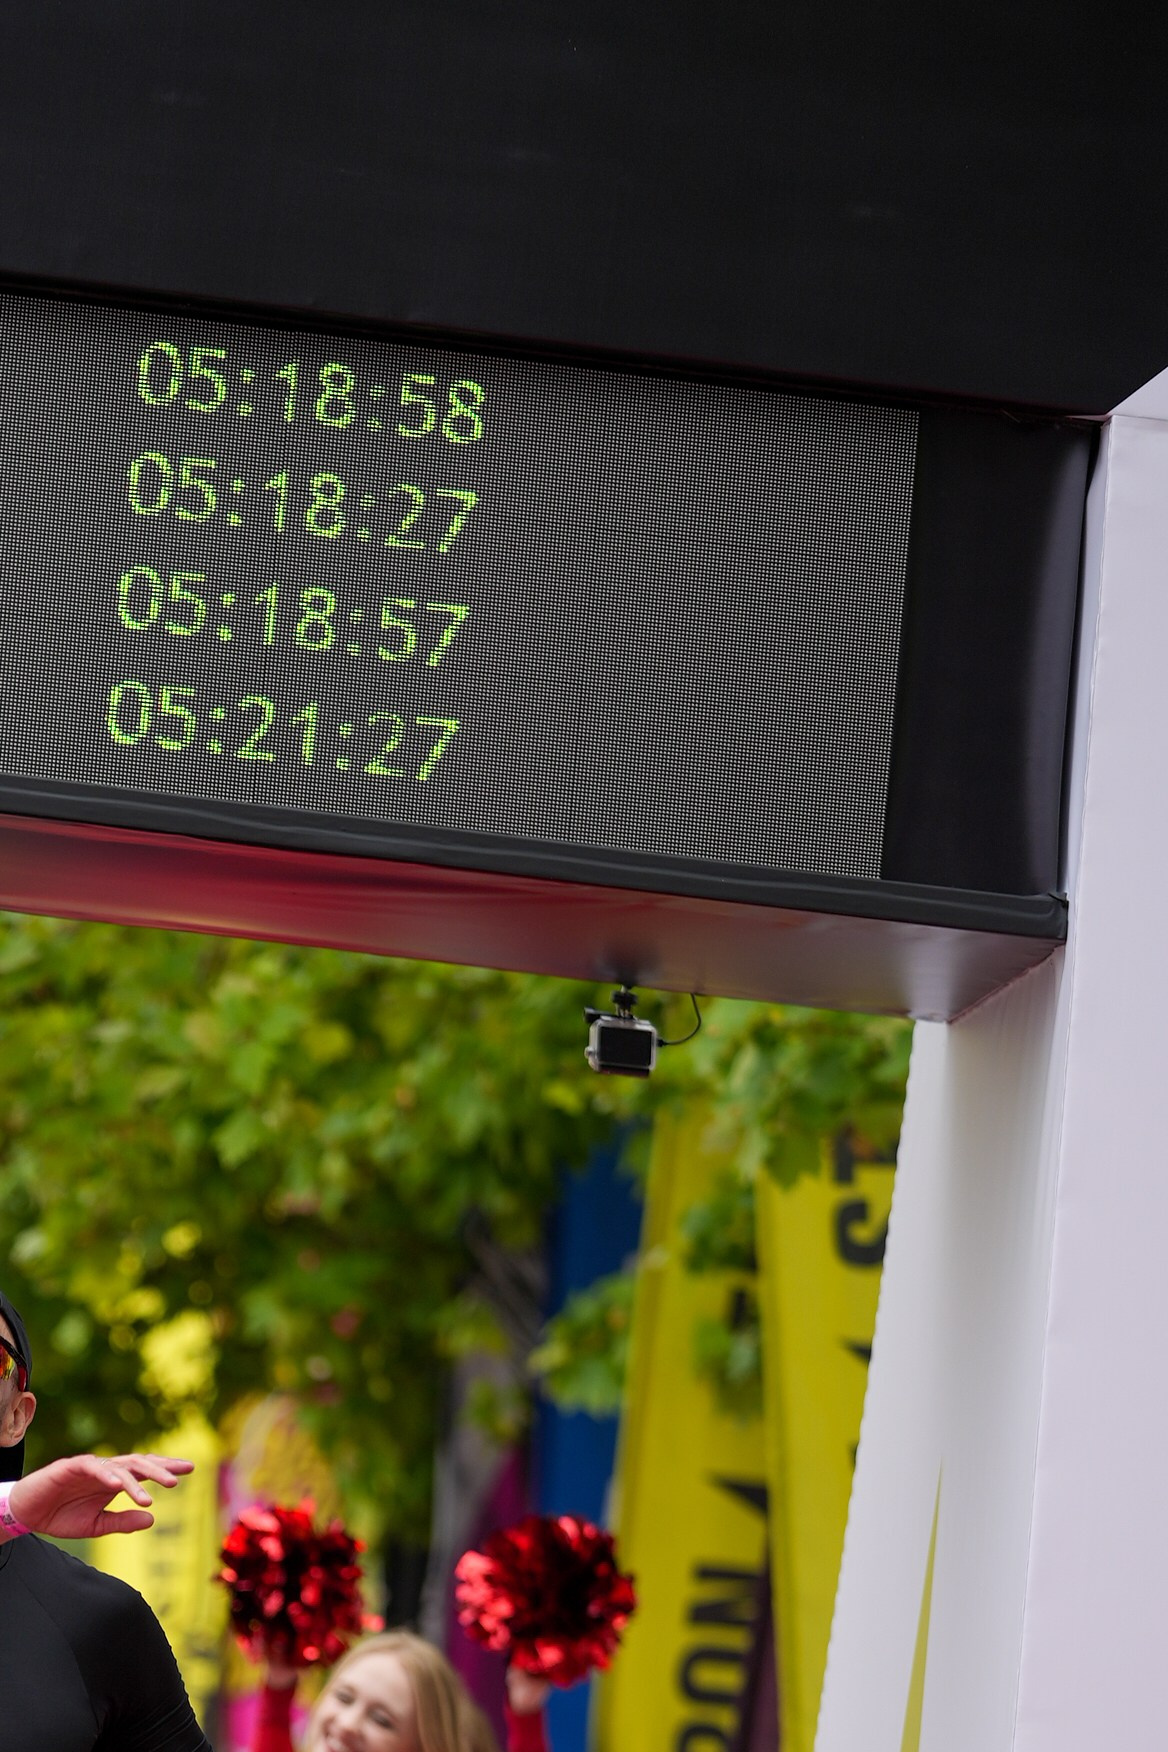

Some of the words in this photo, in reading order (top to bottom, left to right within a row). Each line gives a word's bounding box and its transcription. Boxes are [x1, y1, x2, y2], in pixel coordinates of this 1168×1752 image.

[136, 340, 487, 444] 05:18:58
[127, 450, 480, 553] 05:18:27
[117, 563, 471, 667] 05:18:57
[106, 679, 461, 781] 05:21:27
